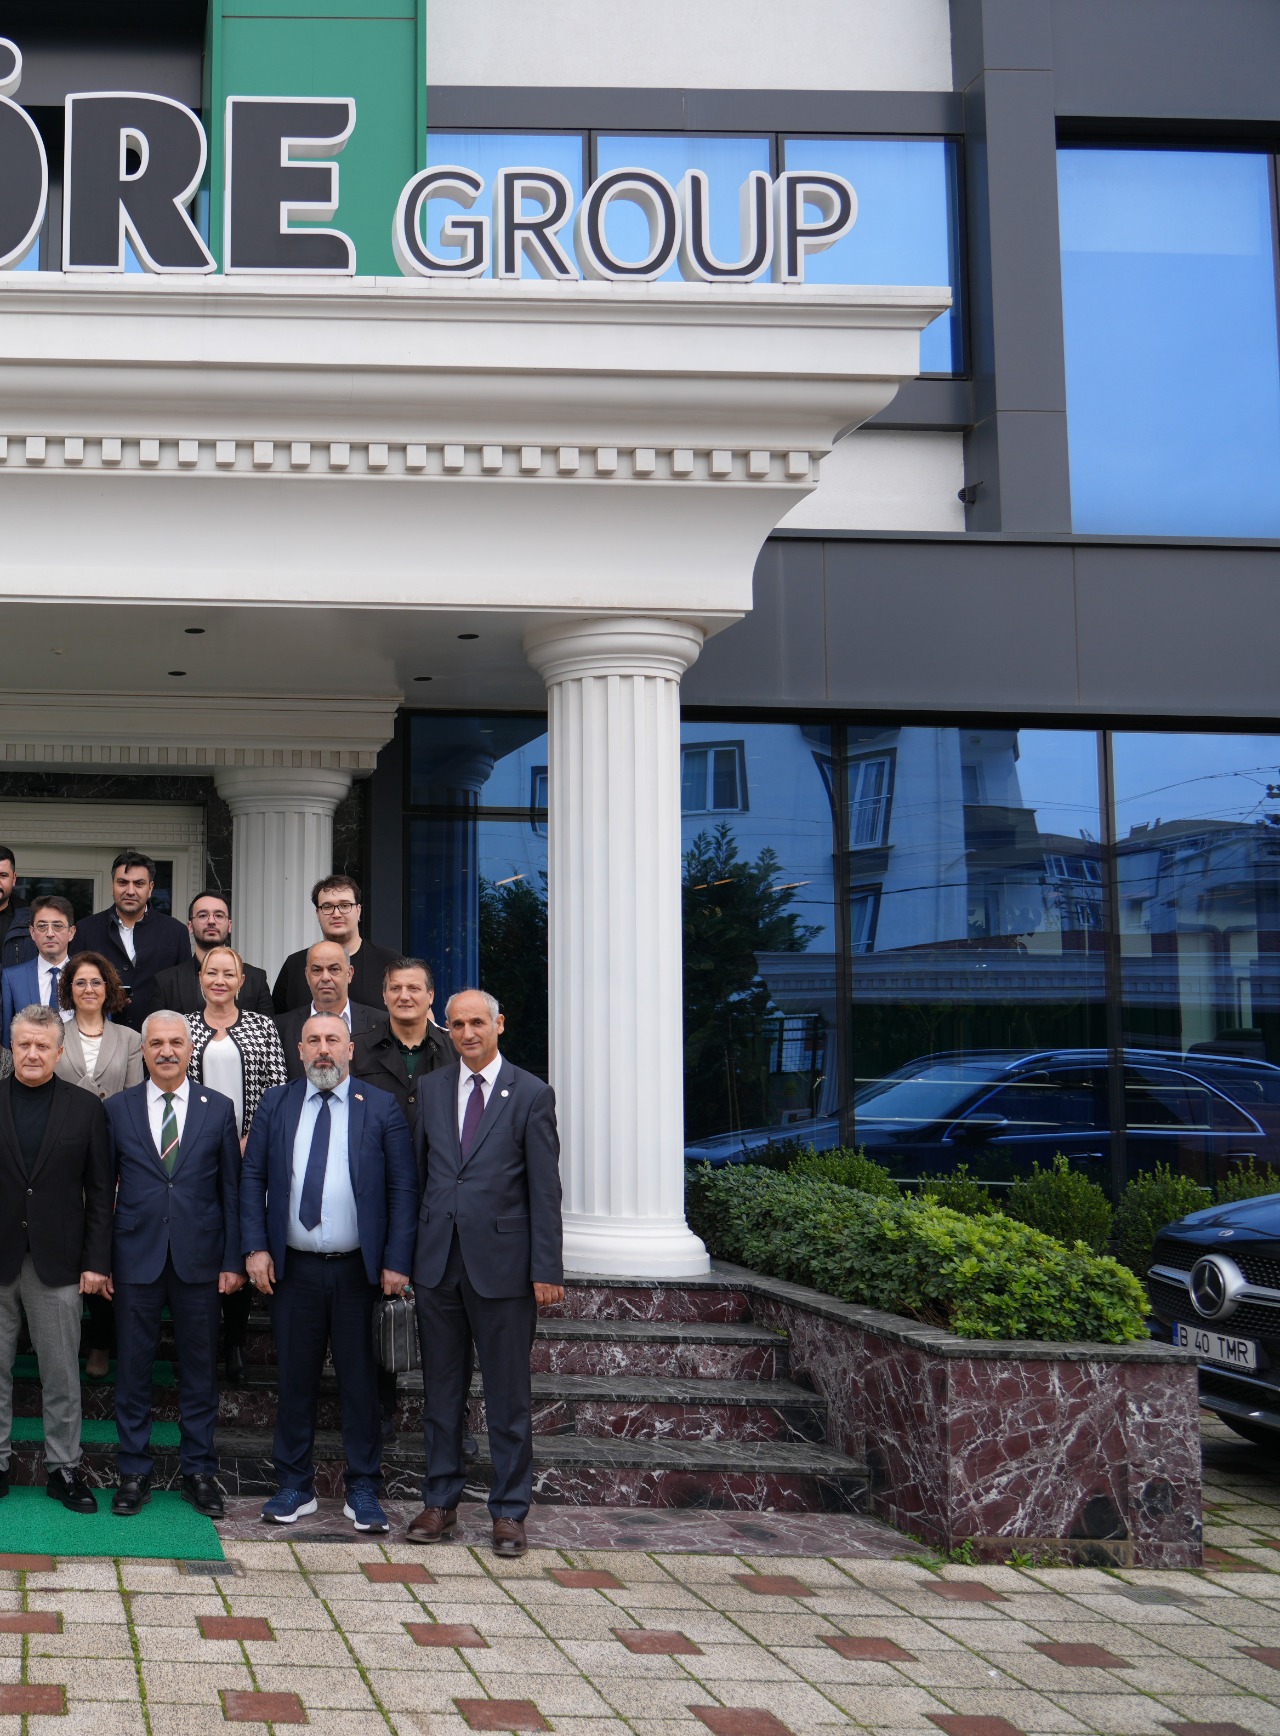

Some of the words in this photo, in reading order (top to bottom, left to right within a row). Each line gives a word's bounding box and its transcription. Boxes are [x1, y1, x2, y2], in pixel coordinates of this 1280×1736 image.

[392, 164, 859, 283] GROUP
[1179, 1326, 1189, 1347] B
[1194, 1330, 1210, 1354] 40
[1217, 1336, 1249, 1364] TMR
